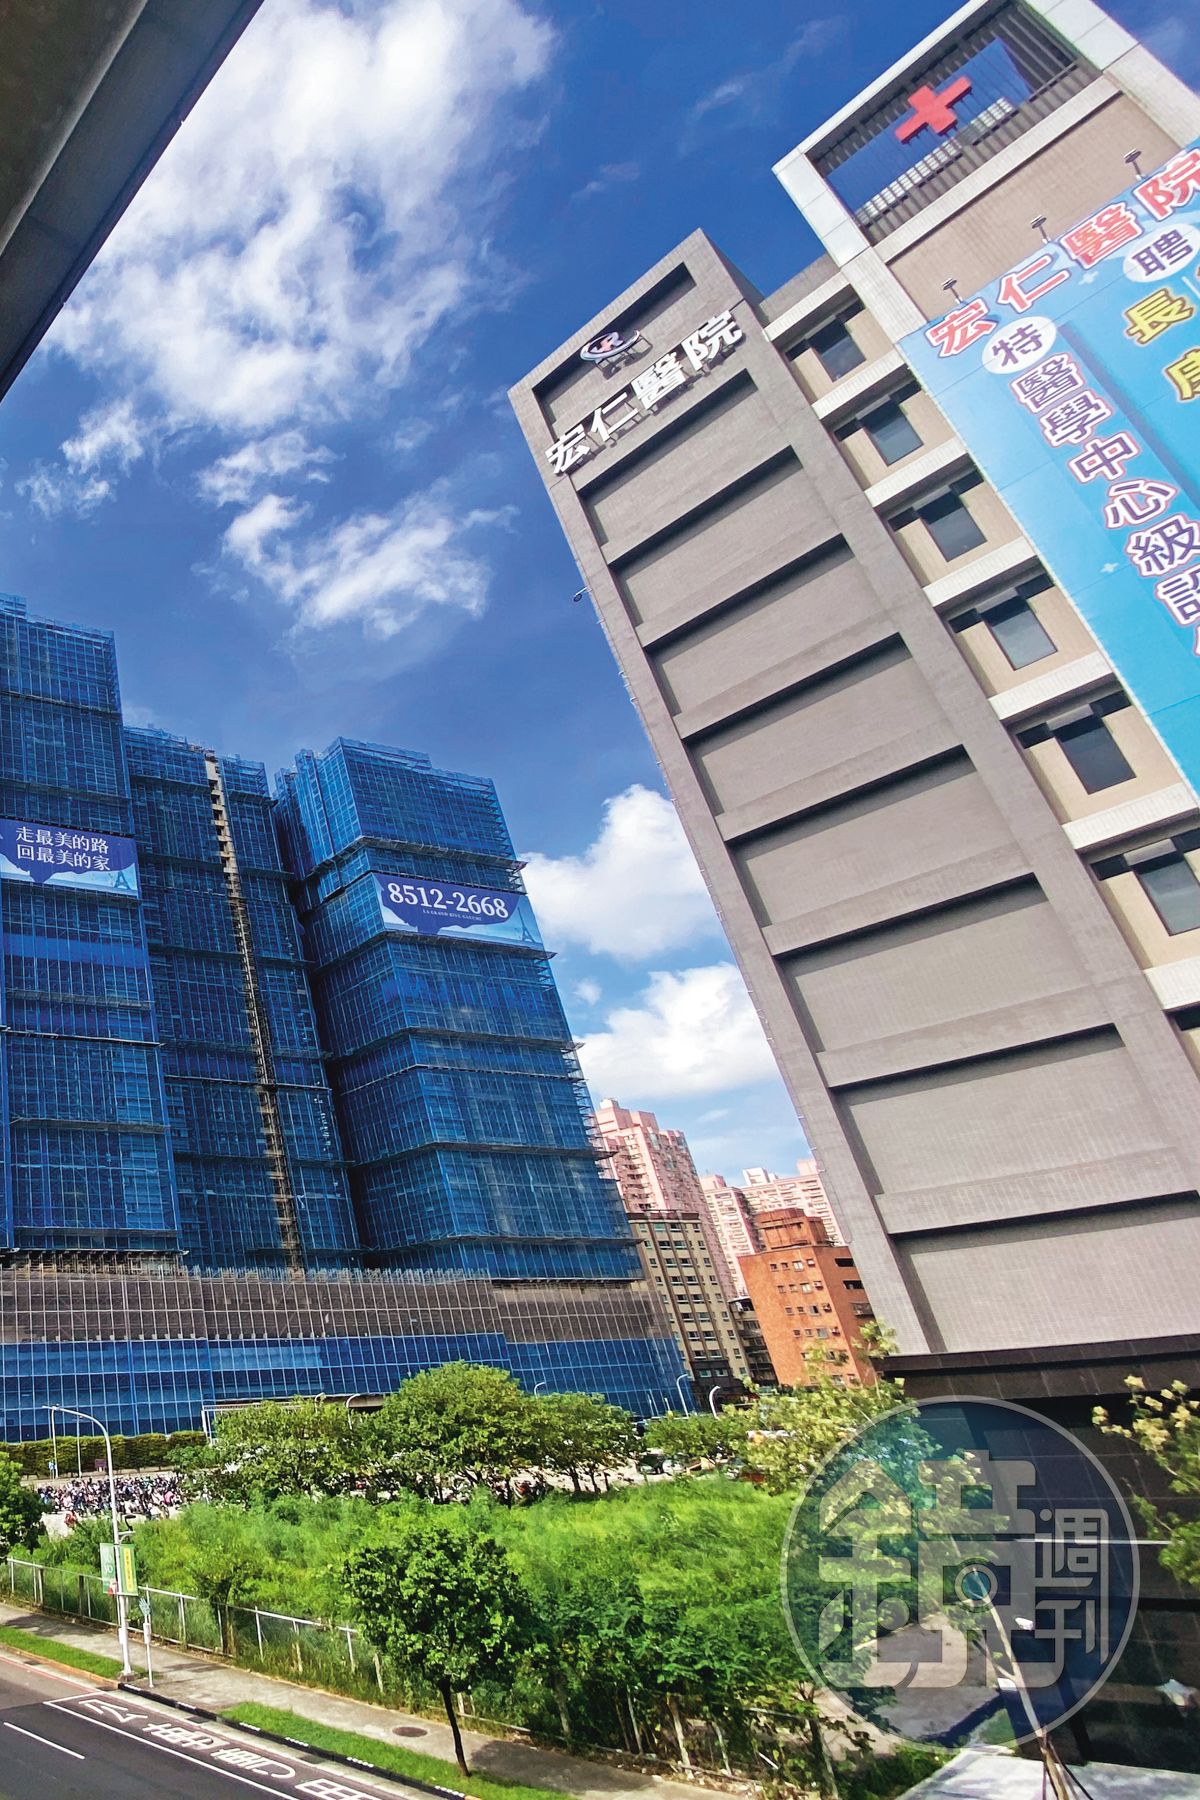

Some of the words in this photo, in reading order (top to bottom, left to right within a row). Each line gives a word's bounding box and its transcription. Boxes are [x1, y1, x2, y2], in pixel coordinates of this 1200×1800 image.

[927, 150, 1200, 354] 宏仁醫院
[992, 323, 1043, 367] 特
[1132, 229, 1193, 276] 聘
[544, 309, 743, 475] 宏仁醫院
[15, 826, 109, 854] 走最美的路
[16, 844, 111, 871] 回最美的家
[387, 882, 509, 918] 8512-2668
